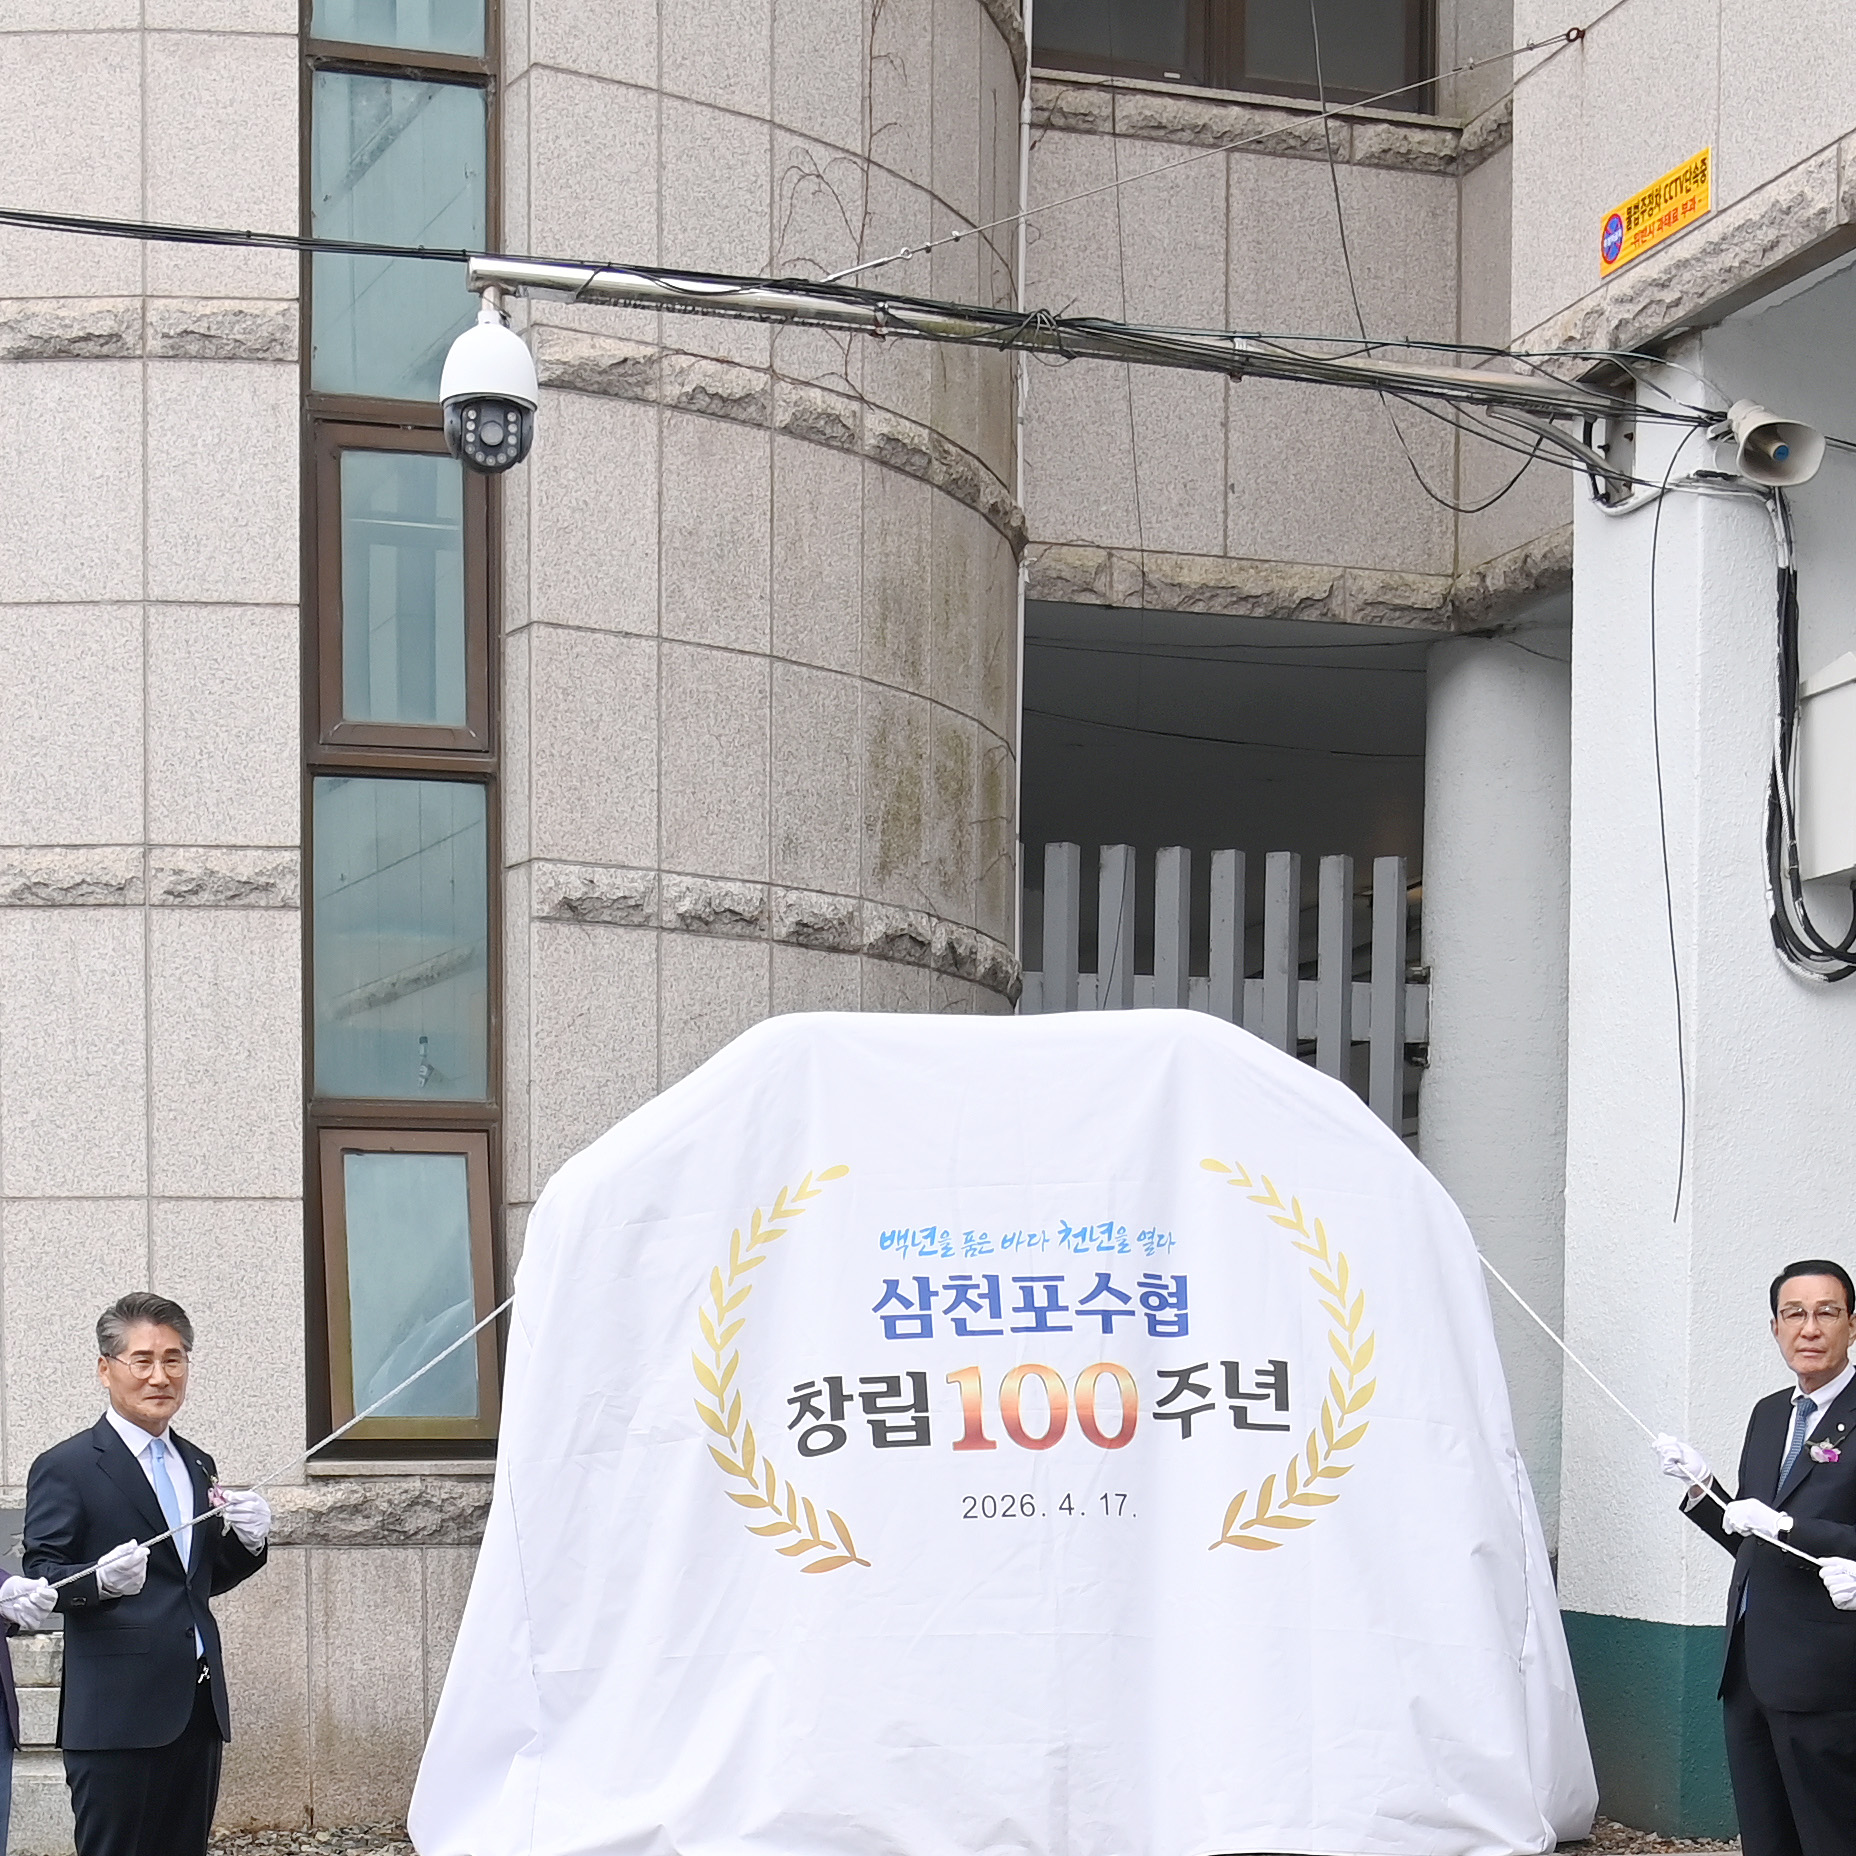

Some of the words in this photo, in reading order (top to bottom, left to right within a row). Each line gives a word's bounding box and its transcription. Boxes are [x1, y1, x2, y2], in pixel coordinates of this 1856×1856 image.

[880, 1225, 955, 1260] 백년을
[961, 1230, 994, 1258] 품은
[1001, 1229, 1049, 1253] 바다
[1058, 1219, 1131, 1254] 천년을
[1137, 1227, 1176, 1257] 열다
[871, 1272, 1189, 1340] 삼천포수협
[786, 1371, 932, 1458] 창립
